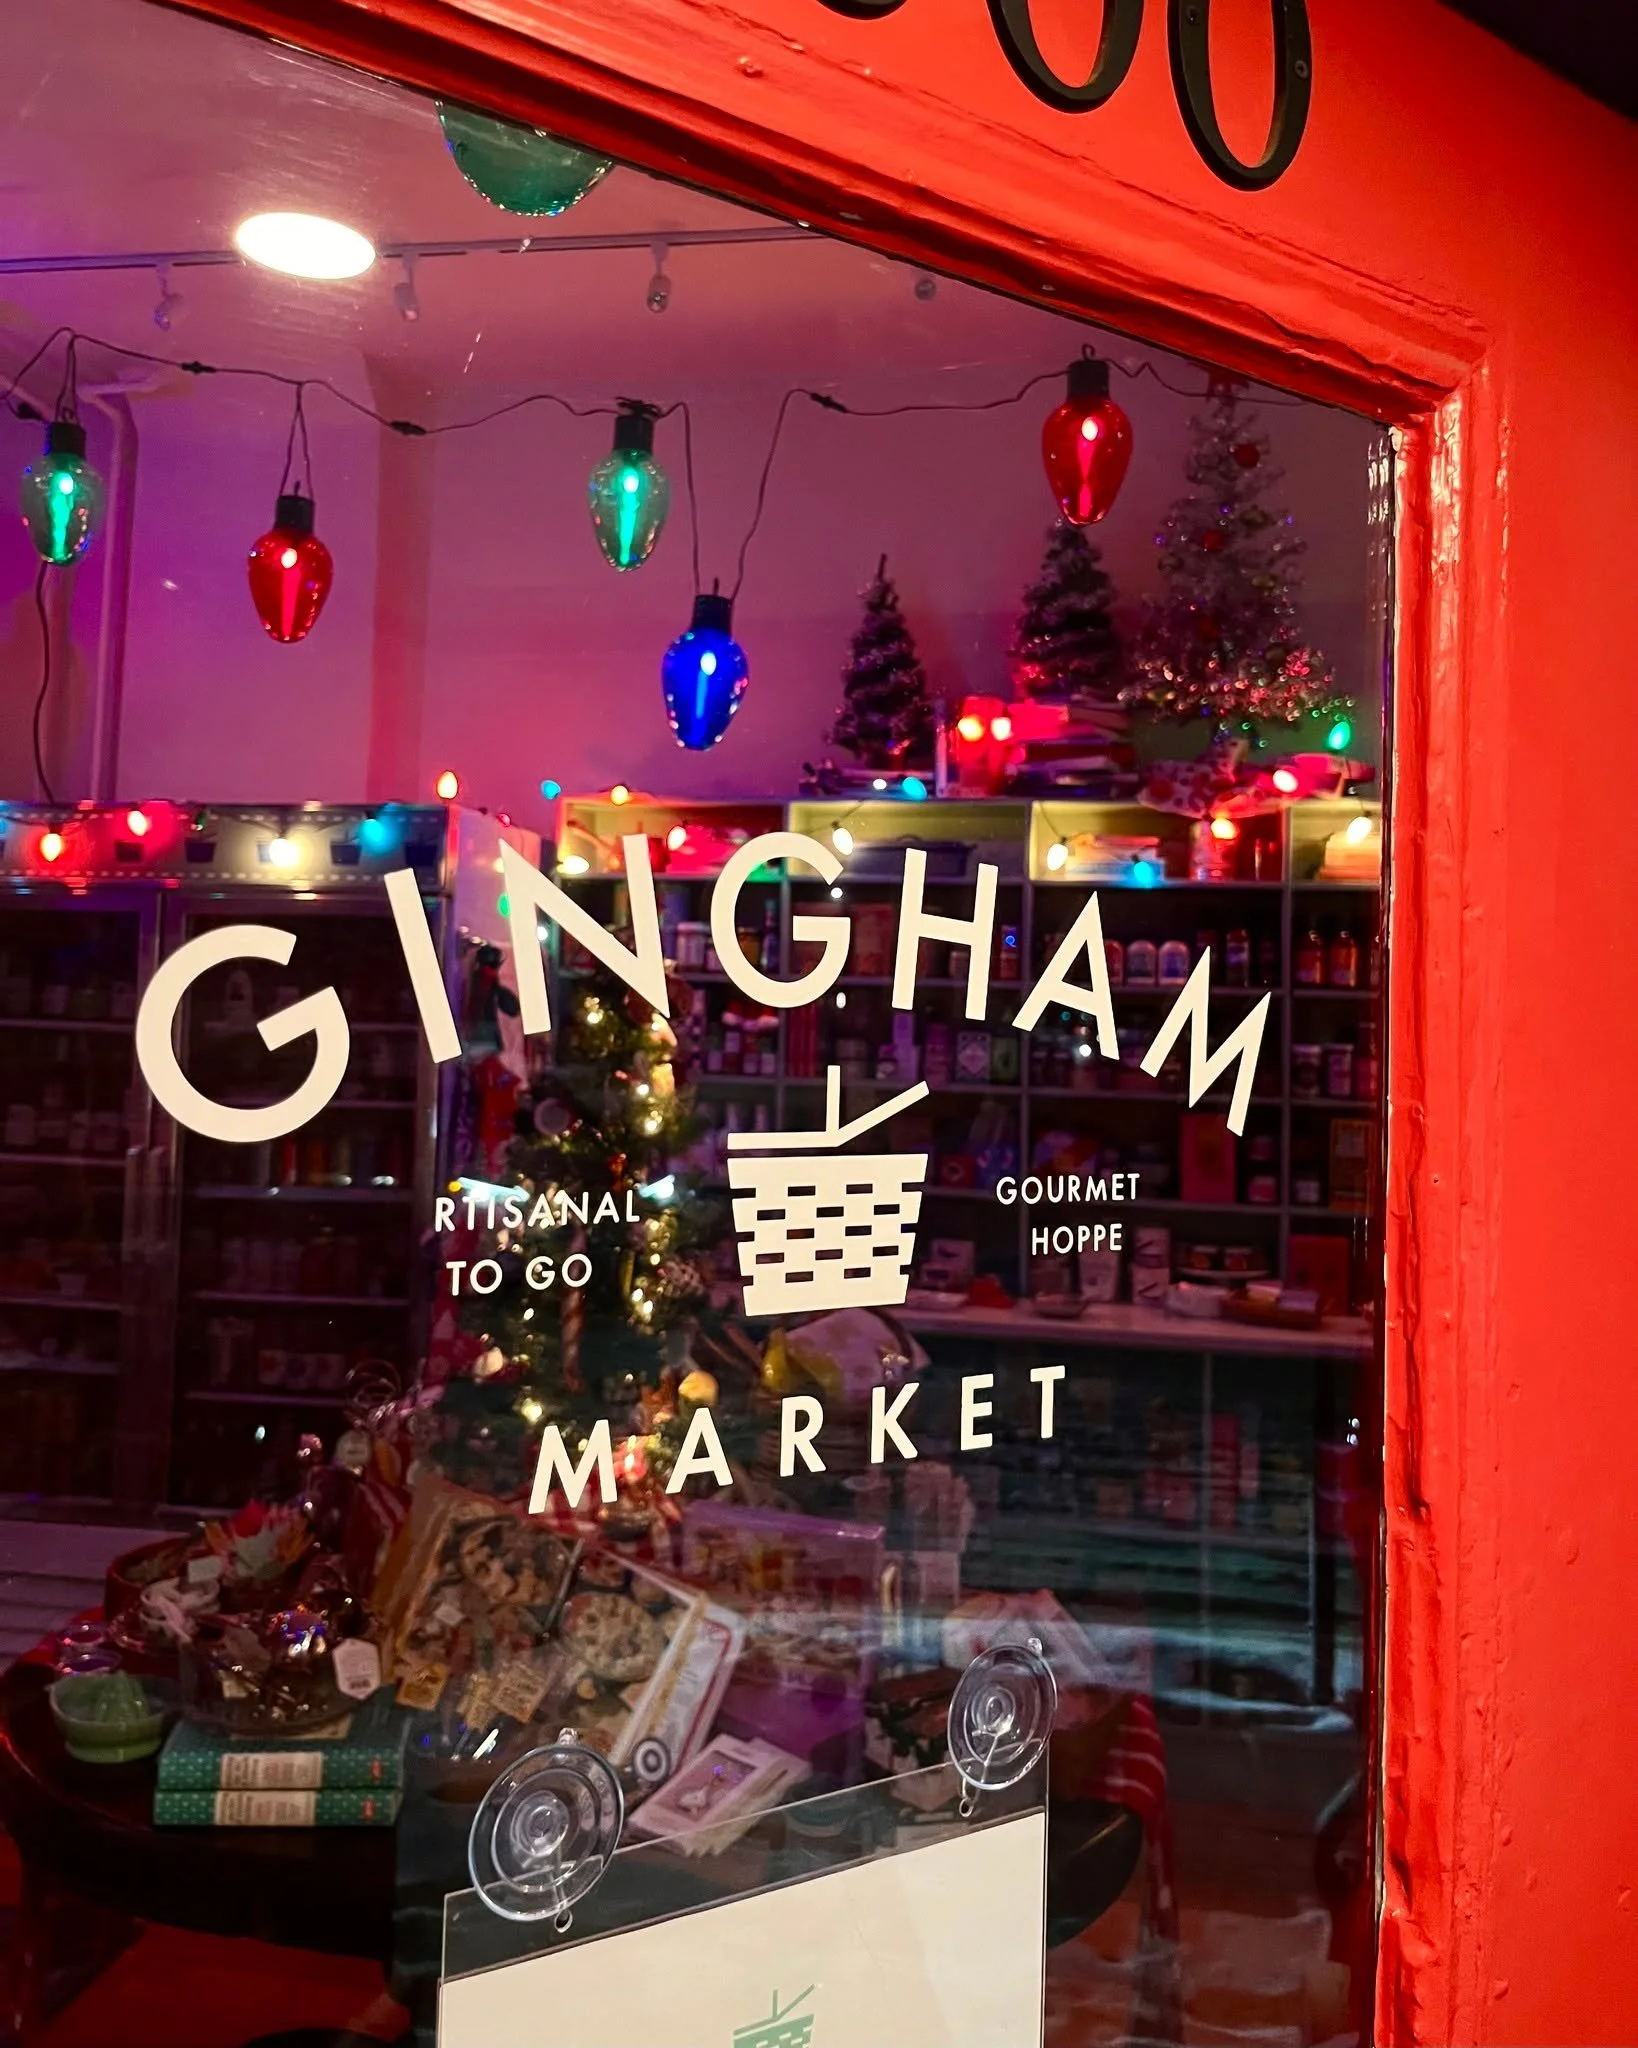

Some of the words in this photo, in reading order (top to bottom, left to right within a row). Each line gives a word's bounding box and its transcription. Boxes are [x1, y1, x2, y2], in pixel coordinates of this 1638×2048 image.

[135, 831, 1272, 1143] GINGHAM
[996, 1173, 1140, 1205] GOURMET
[1032, 1223, 1123, 1256] HOPPE
[446, 1259, 503, 1296] TO
[525, 1253, 593, 1290] GO
[528, 1365, 1067, 1515] MARKET
